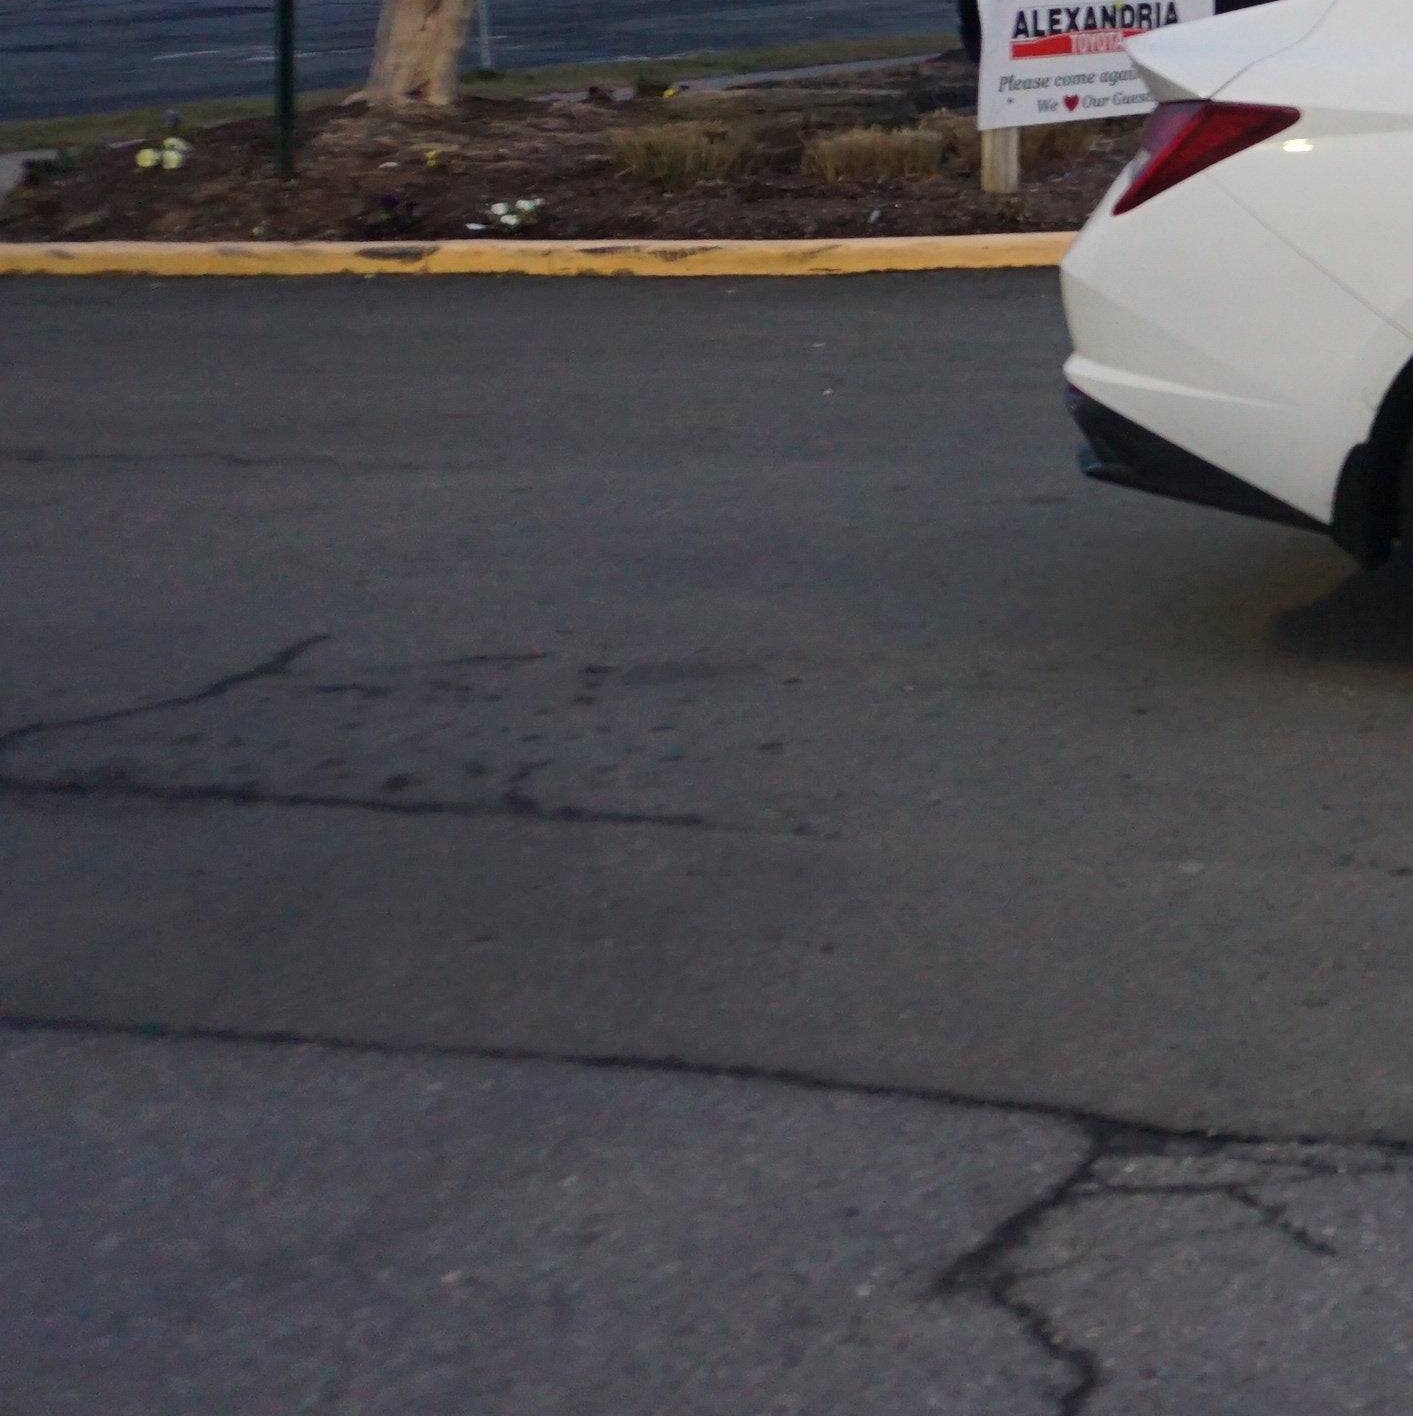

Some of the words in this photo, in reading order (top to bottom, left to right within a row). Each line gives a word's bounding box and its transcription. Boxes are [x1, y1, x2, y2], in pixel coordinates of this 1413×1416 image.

[1012, 1, 1179, 39] ALEXANDRIA
[999, 73, 1051, 92] Please
[1054, 72, 1095, 87] come
[1037, 98, 1059, 113] We
[1081, 93, 1109, 109] Our
